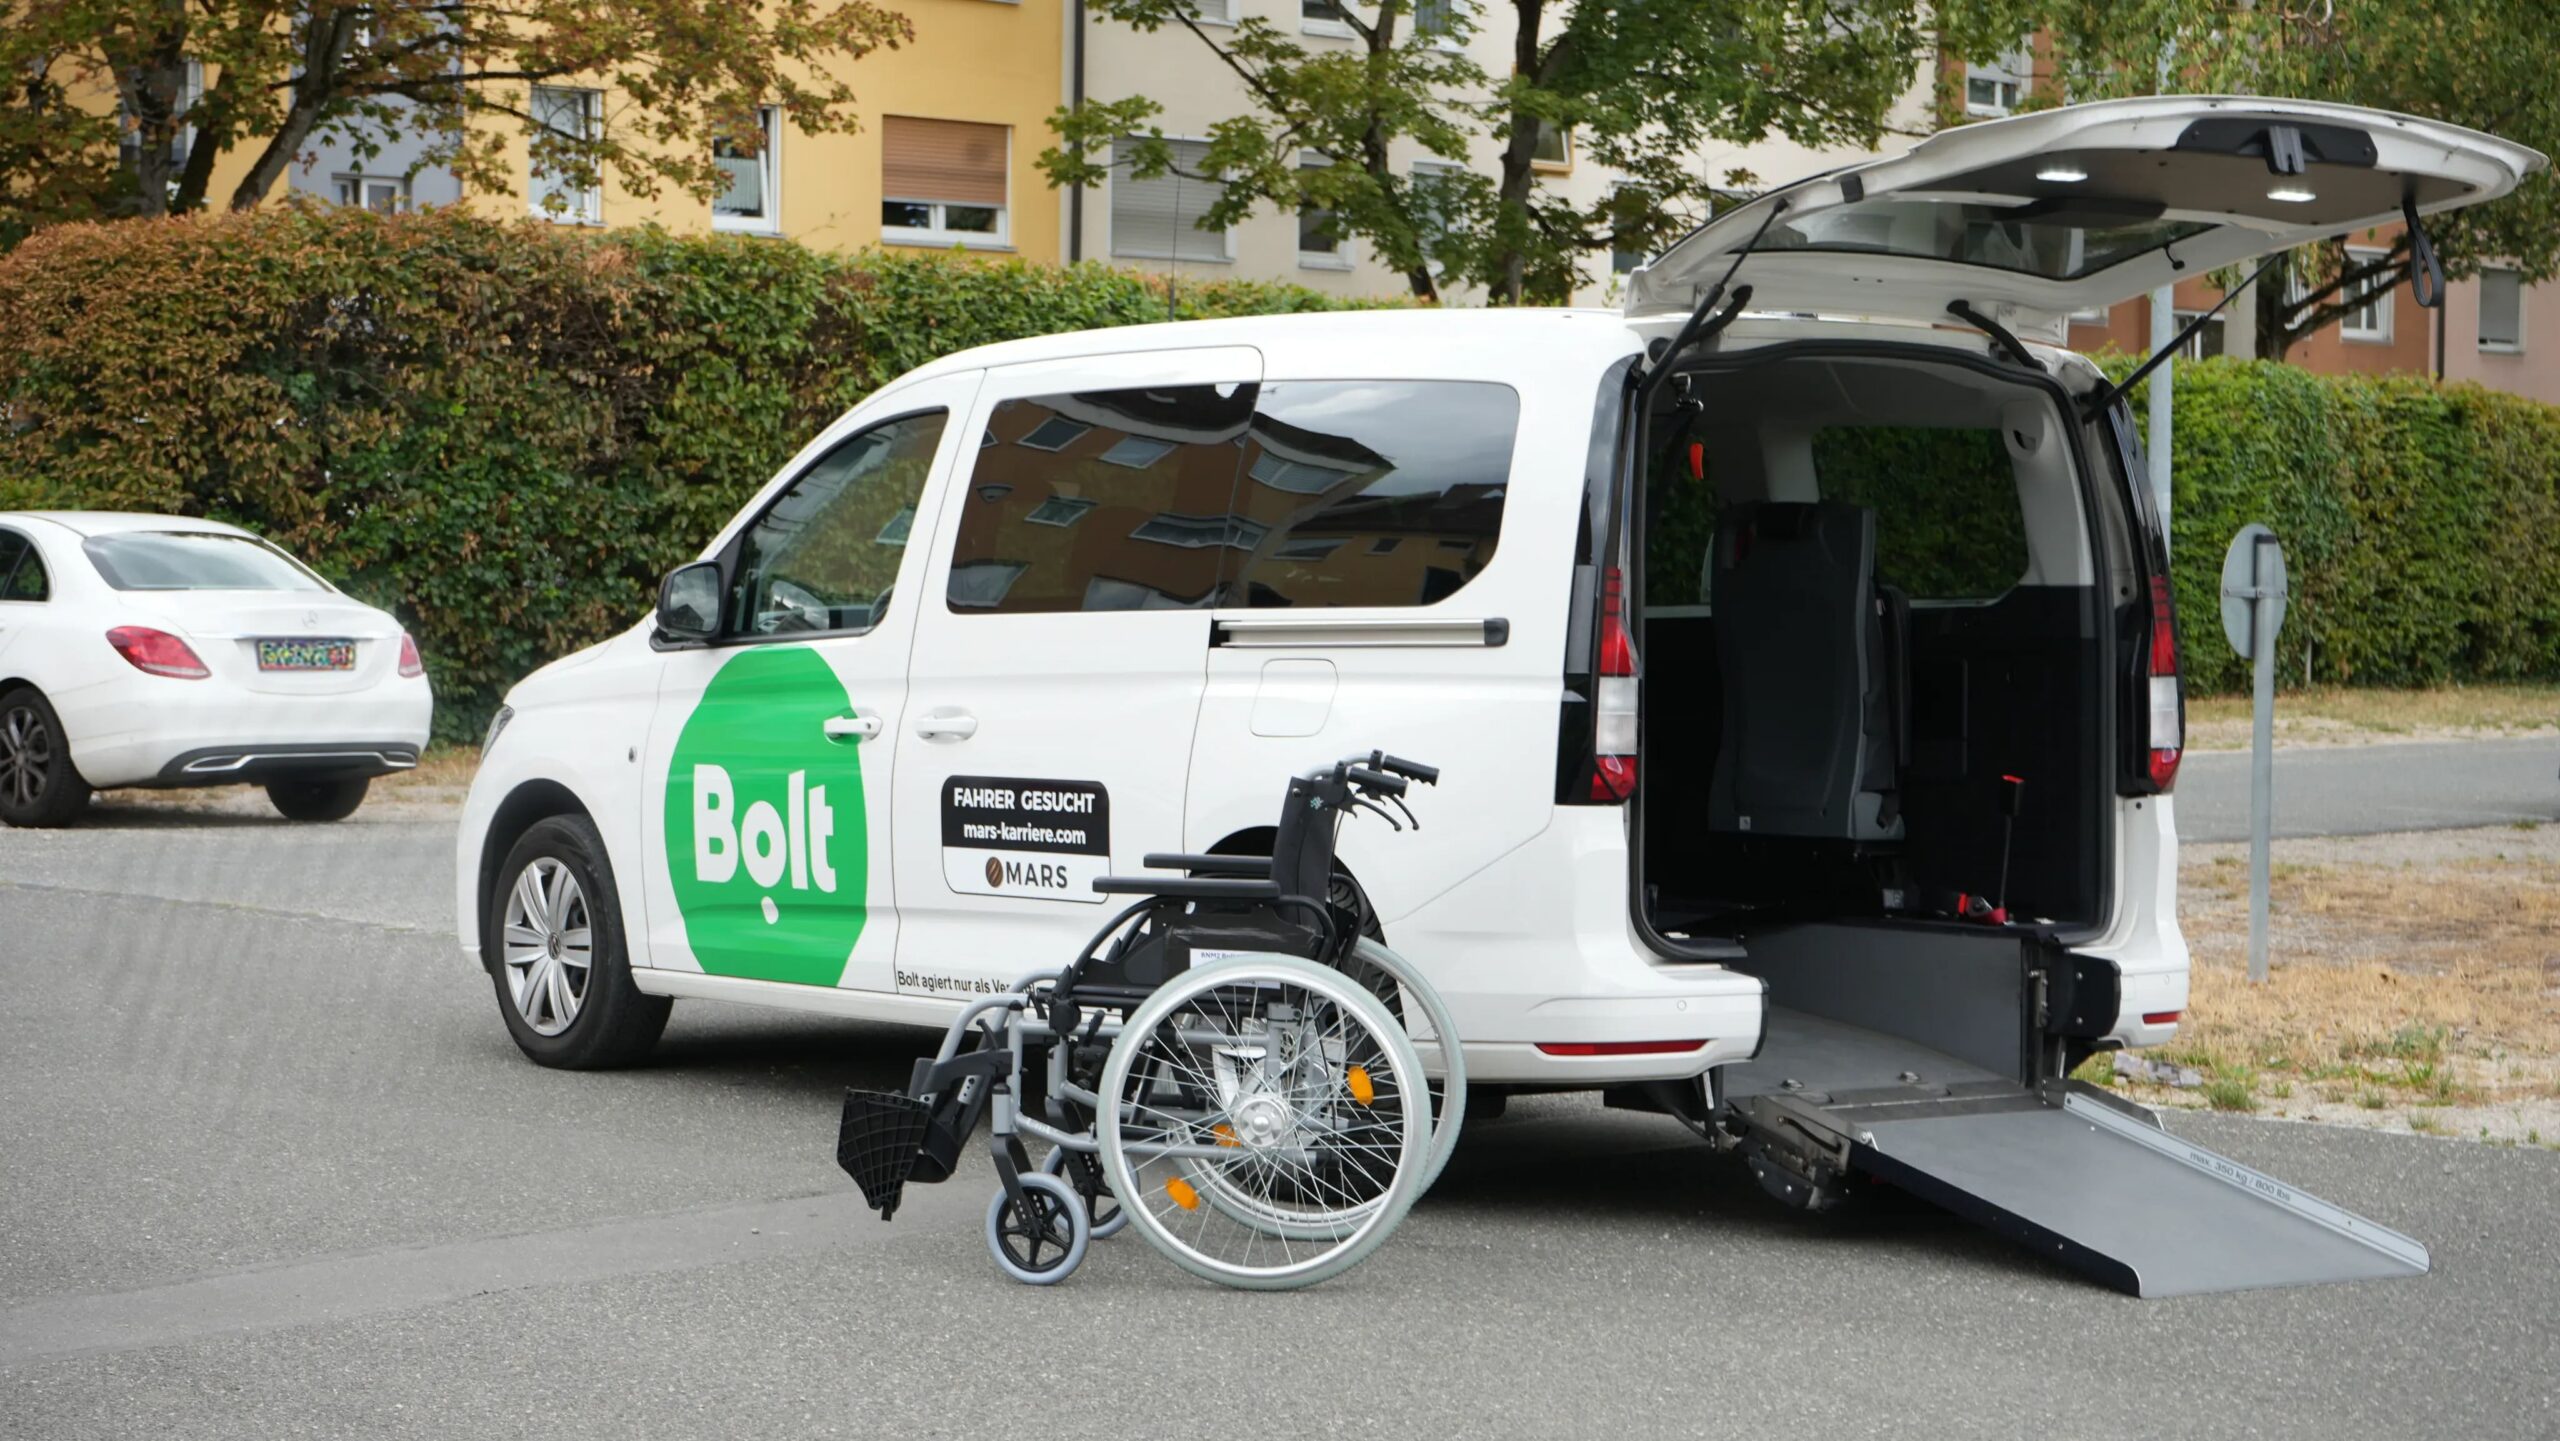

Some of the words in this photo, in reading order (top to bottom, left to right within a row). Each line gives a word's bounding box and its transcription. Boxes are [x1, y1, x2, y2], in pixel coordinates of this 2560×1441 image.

[954, 787, 1015, 810] FAHRER
[1020, 790, 1096, 814] GESUCHT
[694, 764, 836, 893] Bolt
[963, 821, 1086, 845] mars-karriere.com
[1006, 861, 1068, 889] MARS
[898, 971, 919, 987] Bolt
[922, 974, 952, 992] agiert
[954, 979, 972, 991] nur
[975, 977, 990, 994] als
[2215, 1162, 2234, 1176] 350
[2235, 1171, 2248, 1185] kg
[2255, 1180, 2275, 1194] 800
